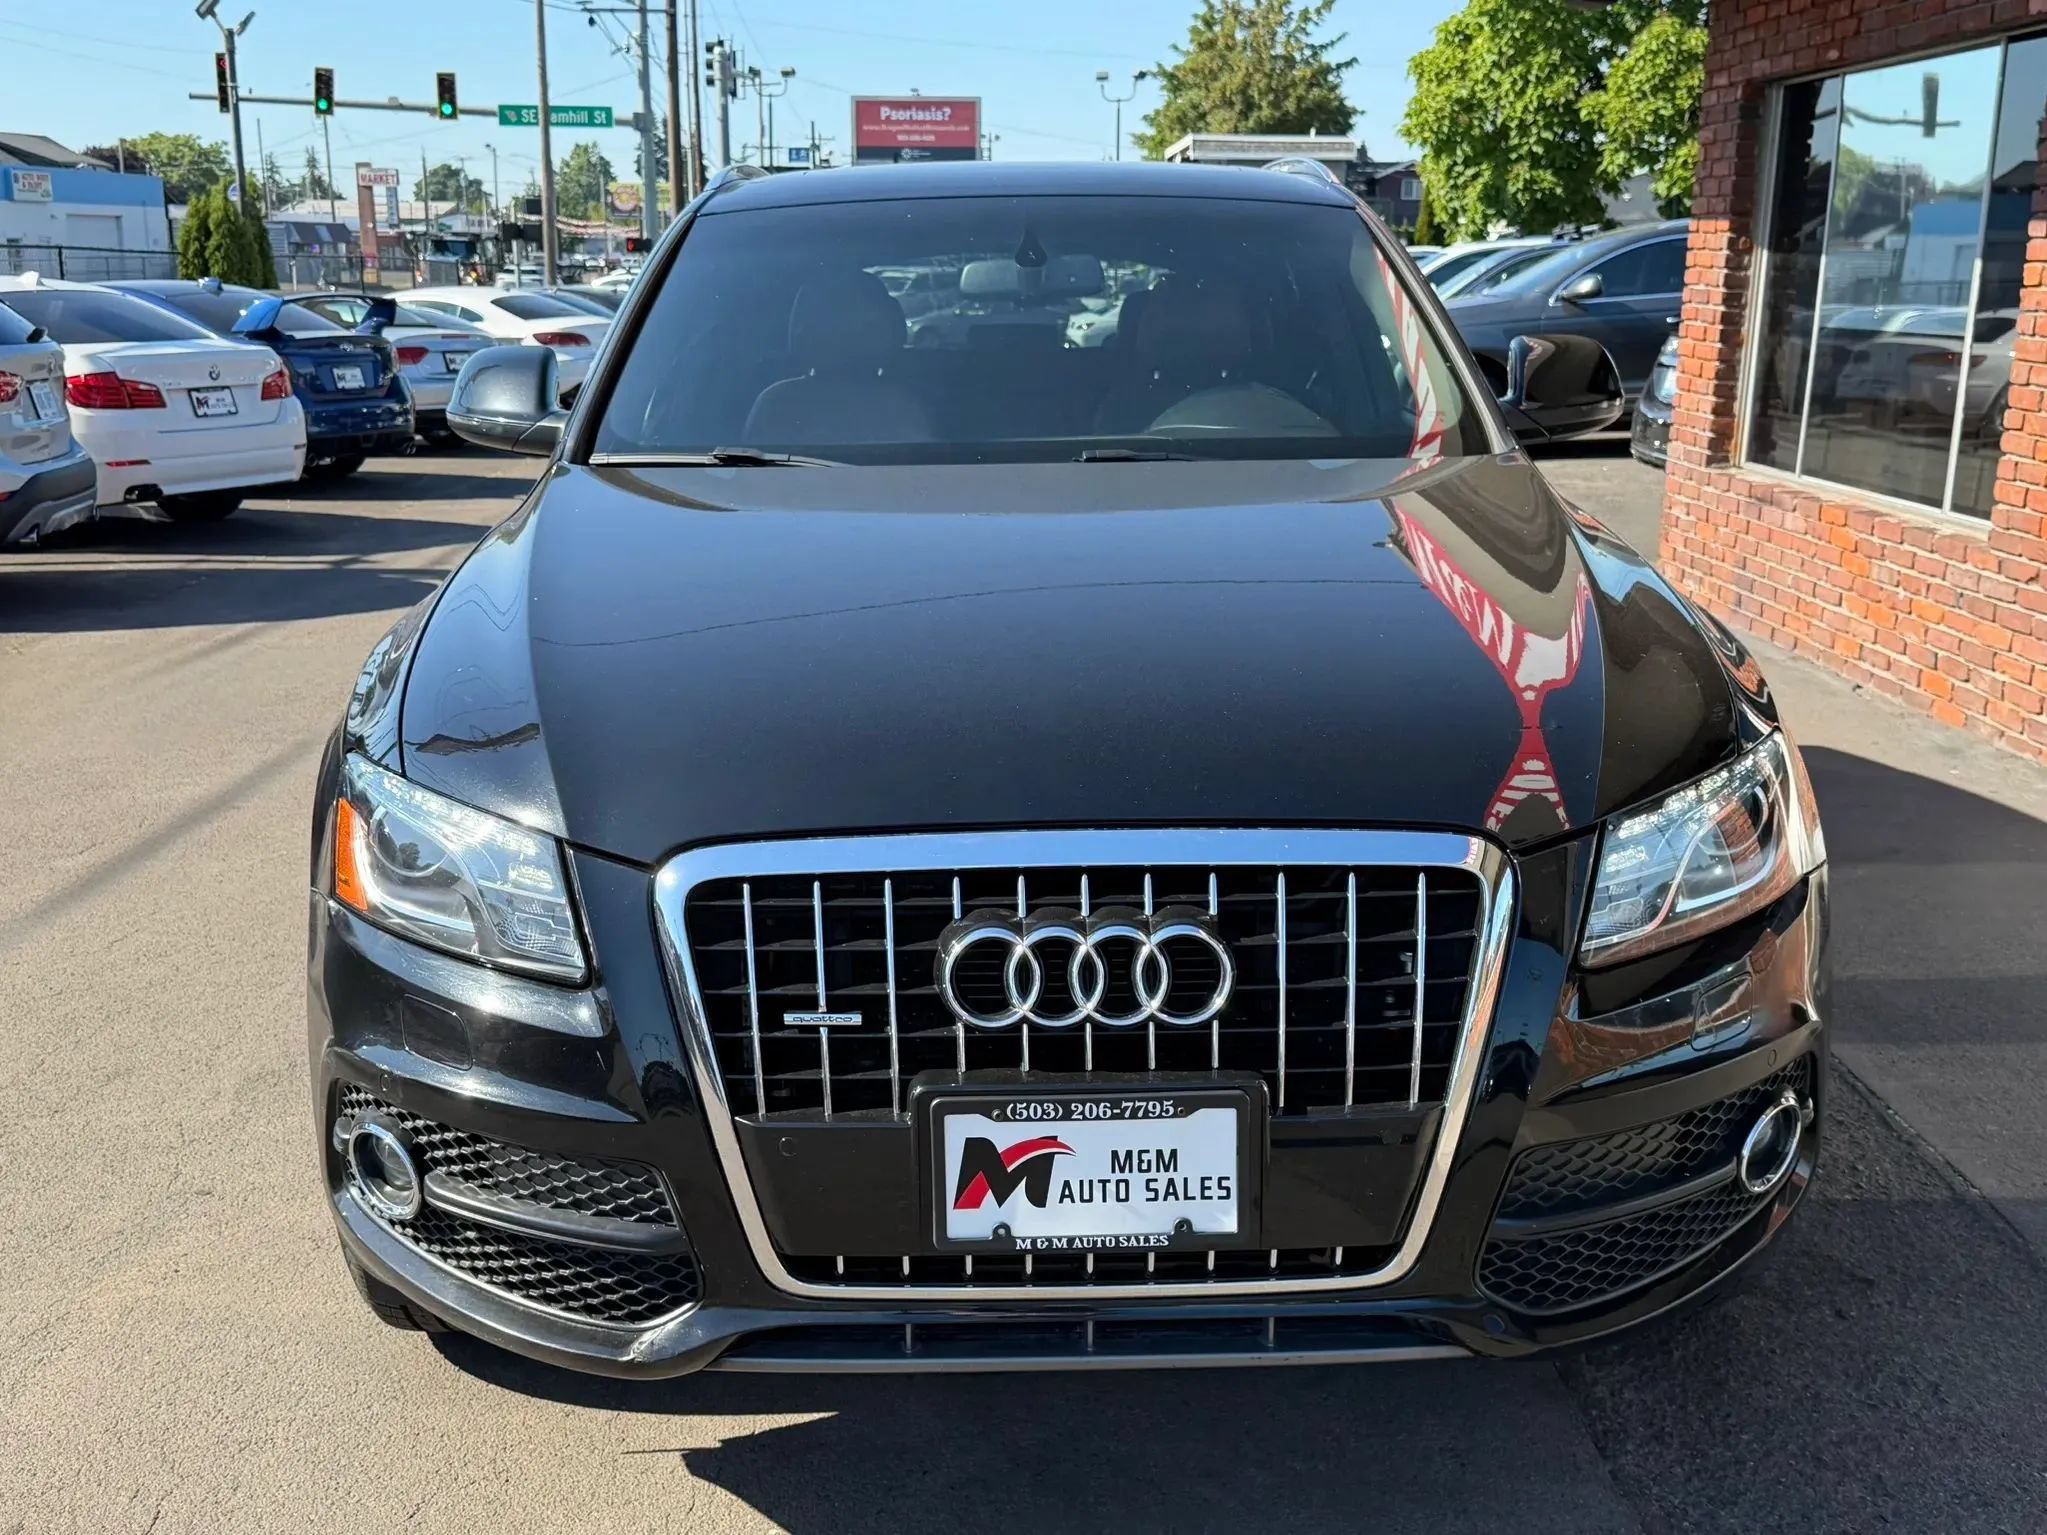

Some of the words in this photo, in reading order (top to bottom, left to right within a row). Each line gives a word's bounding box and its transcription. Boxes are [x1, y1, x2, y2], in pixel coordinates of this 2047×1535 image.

[521, 109, 537, 122] SE
[542, 110, 588, 124] amhill
[594, 111, 606, 124] St
[880, 106, 951, 121] Psoriasis?
[360, 173, 395, 185] MARKET
[793, 1015, 853, 1023] quattro
[1006, 1102, 1063, 1120] (503)
[1071, 1100, 1174, 1119] 206-7795
[1111, 1149, 1178, 1174] M&M
[1059, 1179, 1130, 1204] AUTO
[1145, 1177, 1231, 1202] SALES
[1015, 1238, 1032, 1250] M
[1052, 1238, 1068, 1249] M
[1073, 1236, 1116, 1248] AUTO
[1119, 1235, 1169, 1248] SALES
